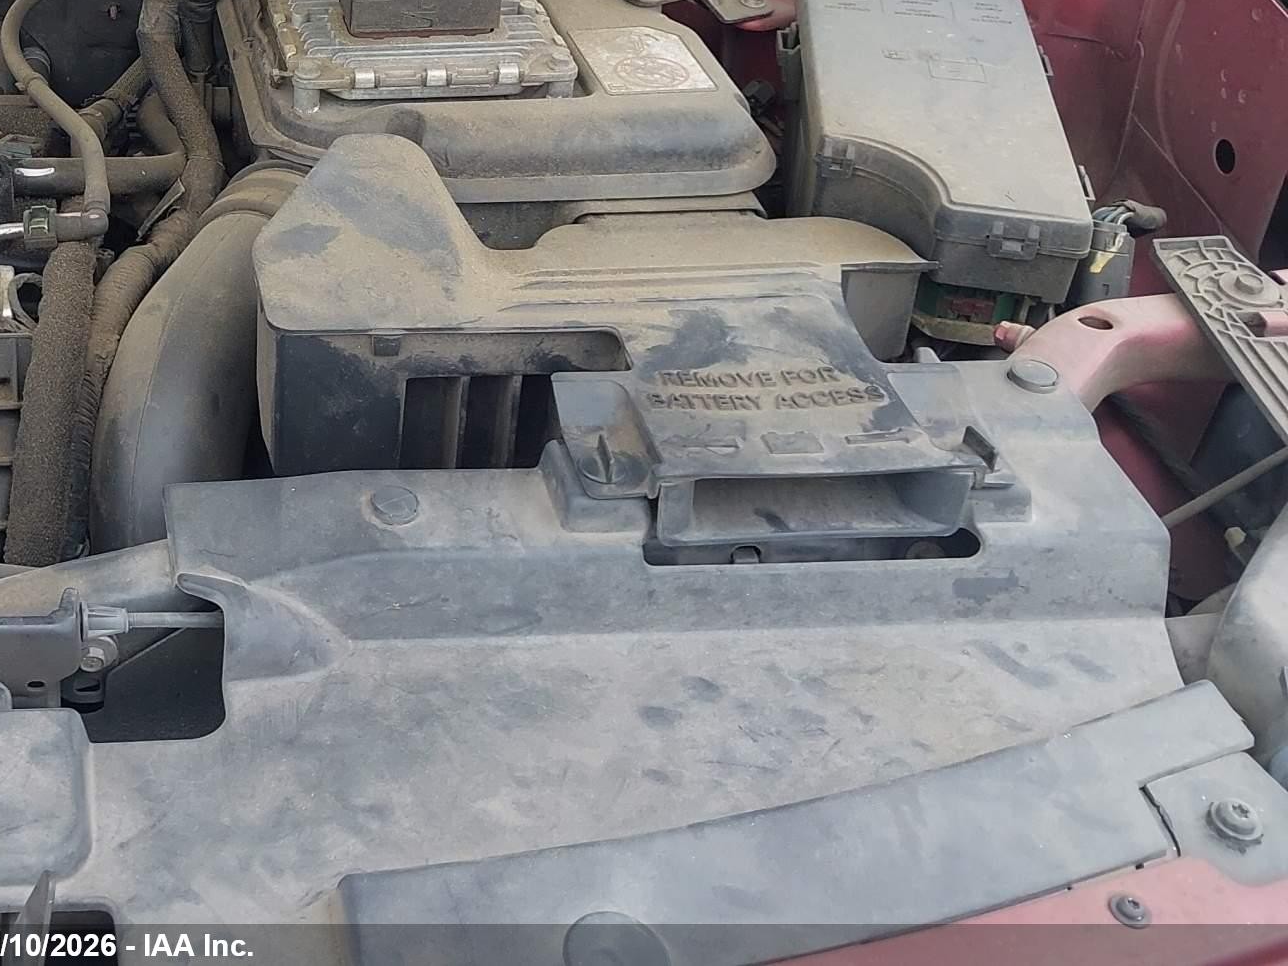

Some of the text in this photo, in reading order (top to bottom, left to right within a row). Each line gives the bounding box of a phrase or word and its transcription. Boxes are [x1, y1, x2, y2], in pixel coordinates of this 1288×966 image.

[657, 366, 842, 388] REMOVE FOR
[646, 384, 886, 411] BATTERY ACCESS
